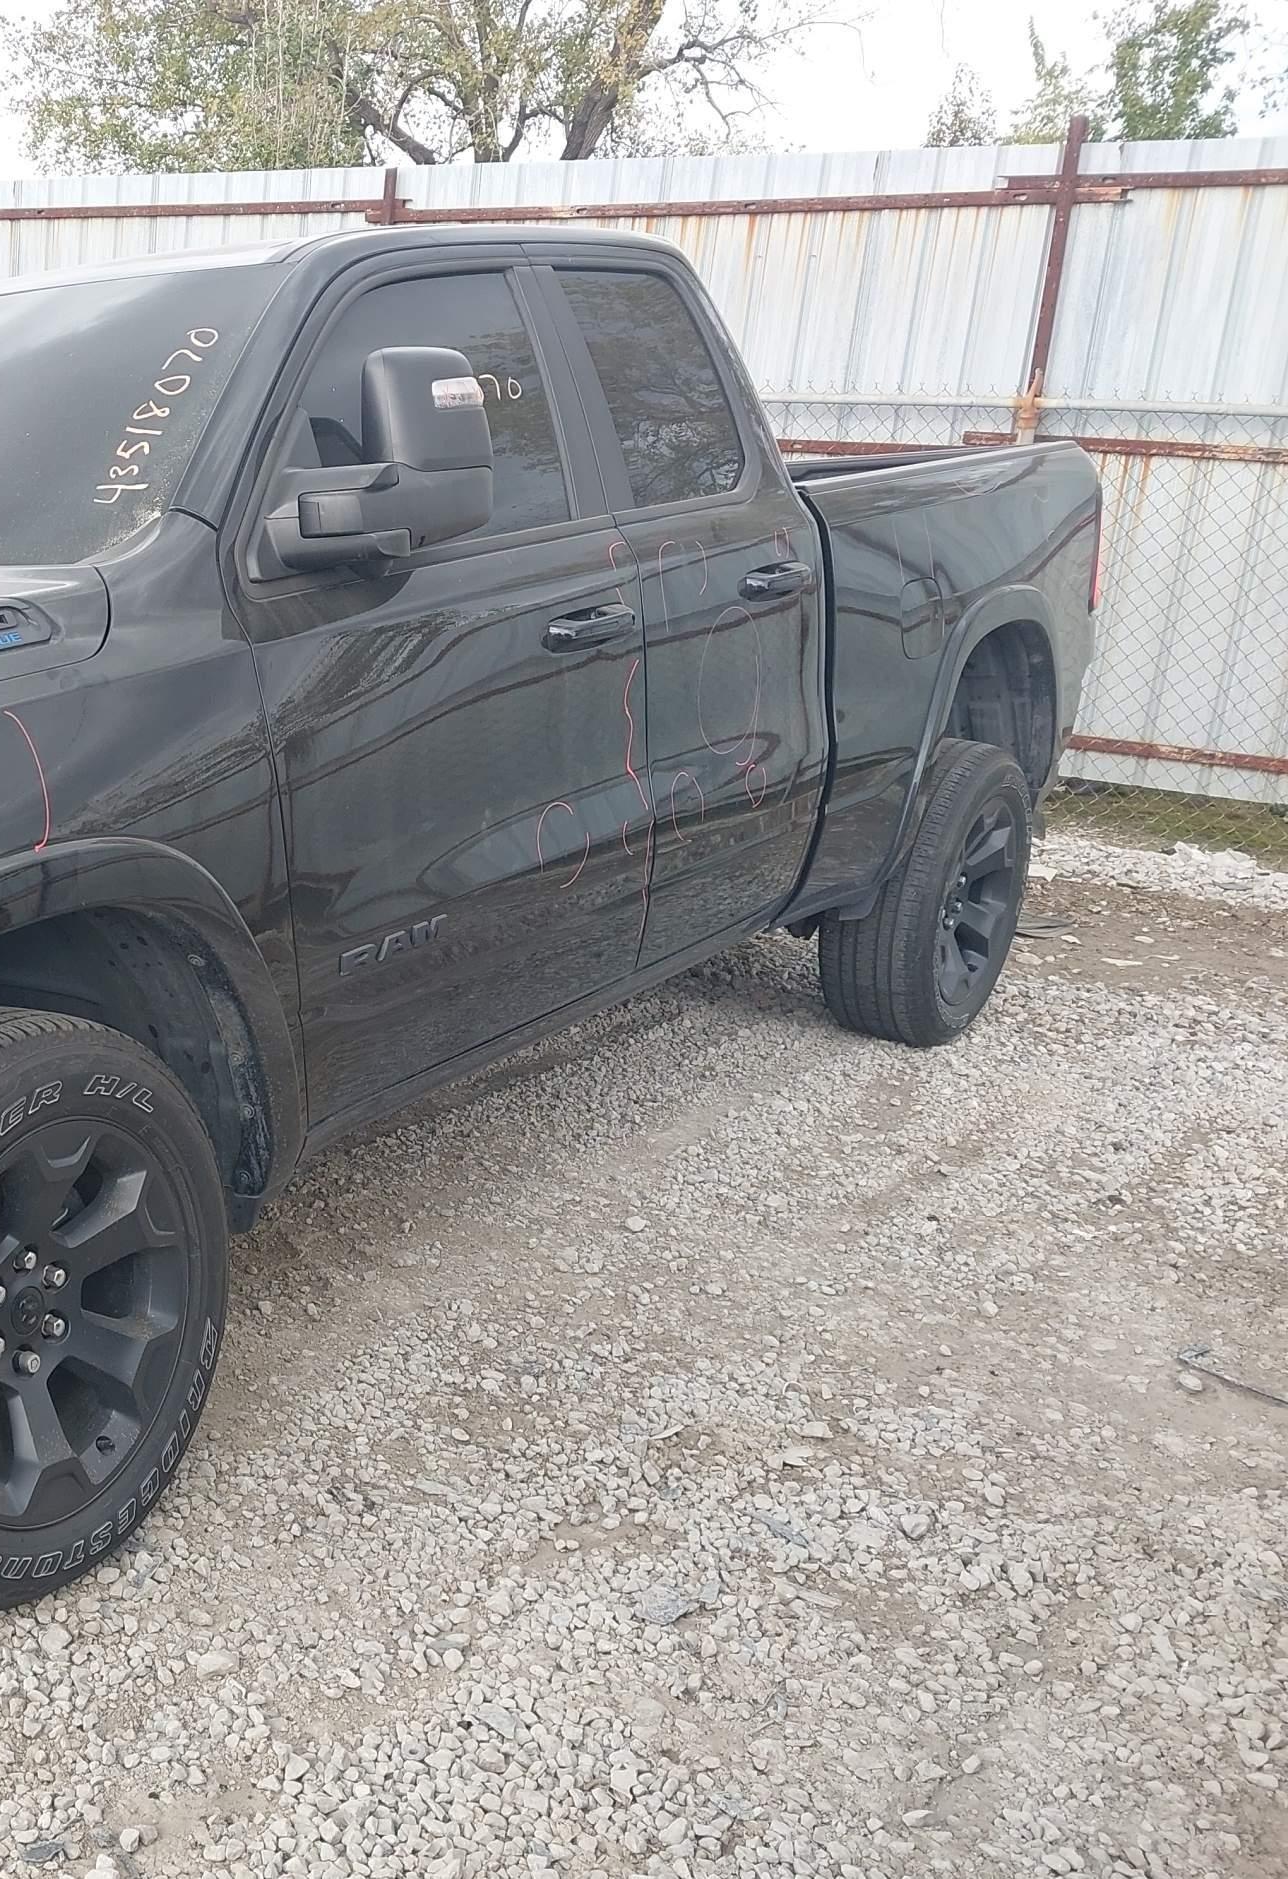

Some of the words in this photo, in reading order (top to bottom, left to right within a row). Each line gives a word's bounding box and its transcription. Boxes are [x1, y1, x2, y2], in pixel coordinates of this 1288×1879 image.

[93, 327, 219, 505] 43518070
[339, 913, 448, 976] RAM
[83, 1074, 154, 1113] H/L
